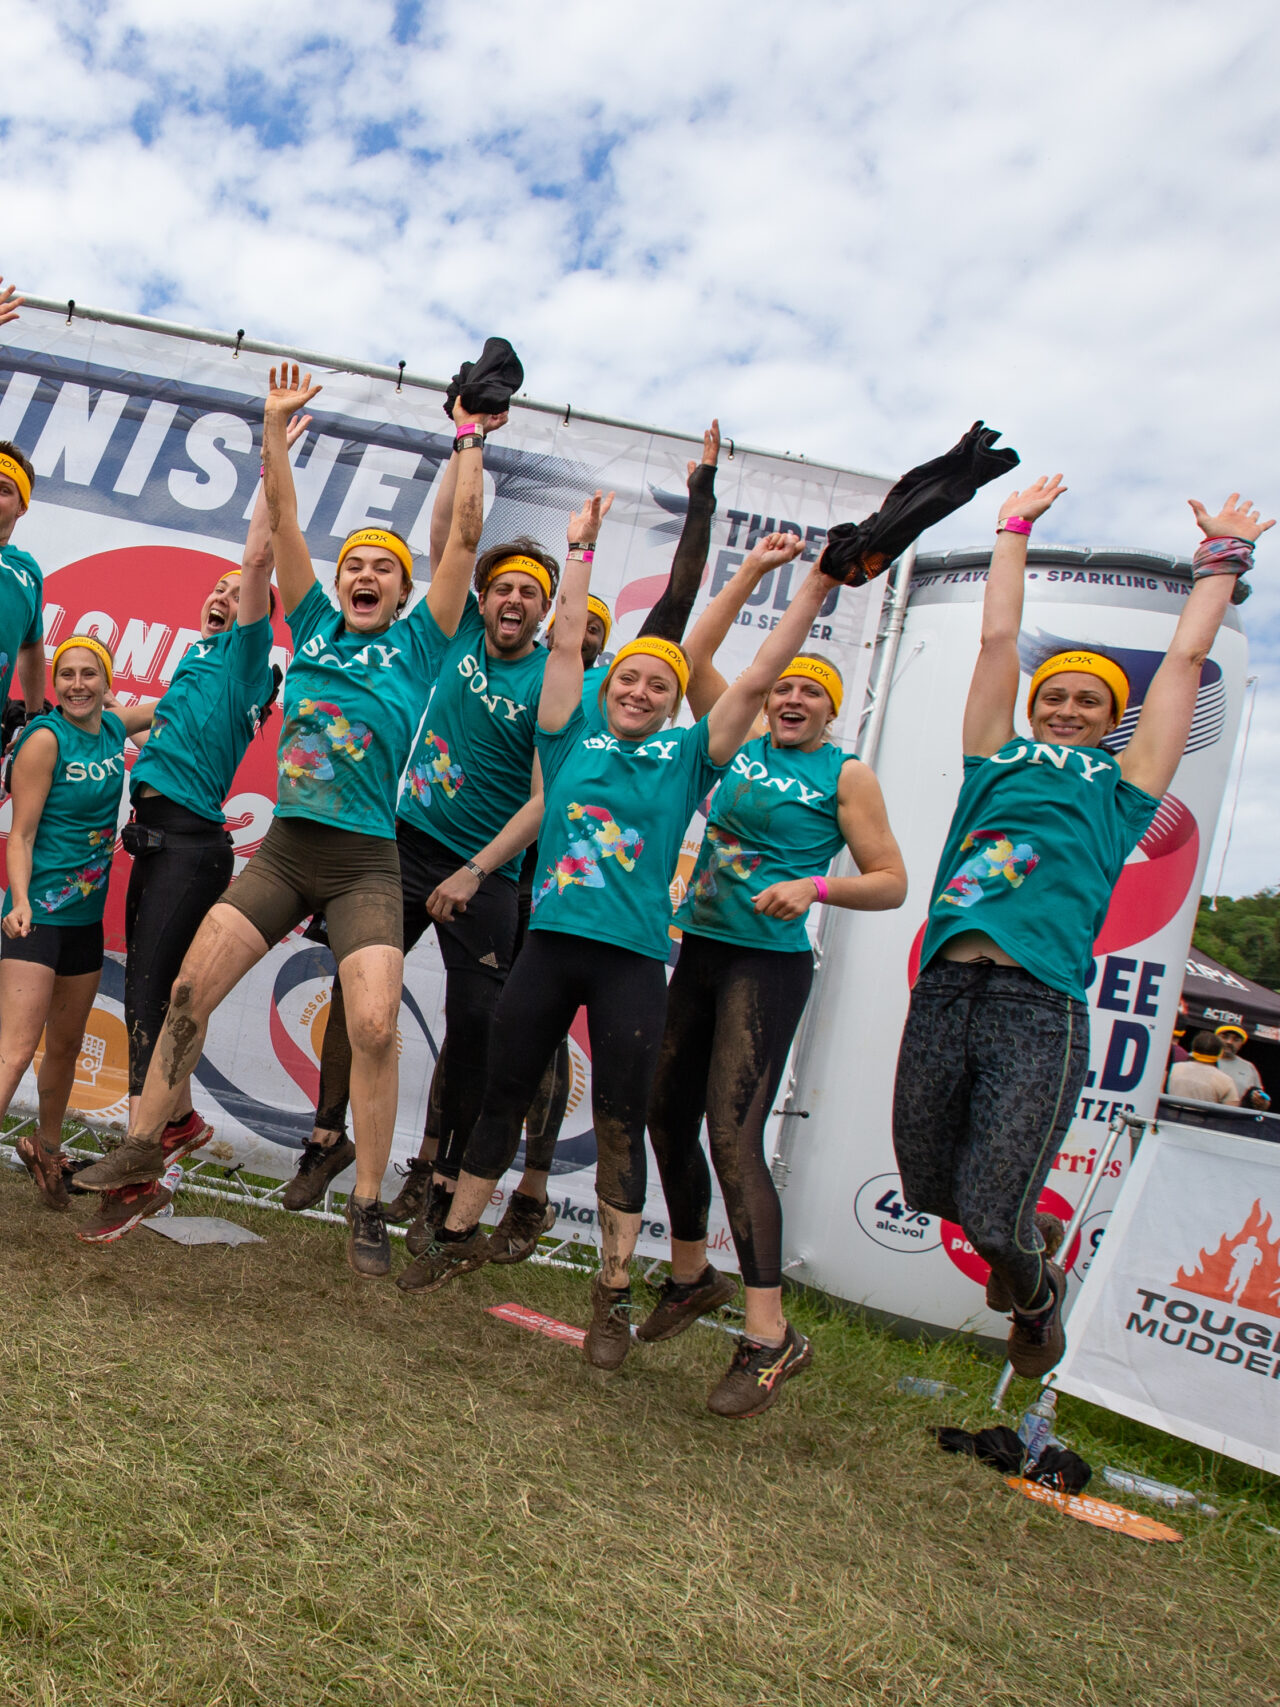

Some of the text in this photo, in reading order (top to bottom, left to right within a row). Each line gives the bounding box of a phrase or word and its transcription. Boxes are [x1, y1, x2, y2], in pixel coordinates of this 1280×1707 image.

[726, 508, 827, 563] THRE
[942, 569, 990, 585] FLAV
[1046, 570, 1158, 591] SPARKLING
[757, 614, 833, 641] SEER
[457, 653, 528, 722] SONY
[730, 752, 824, 805] SONY
[990, 743, 1113, 783] ONY
[299, 989, 328, 1027] KISS OF
[875, 1219, 925, 1240] alc.vol
